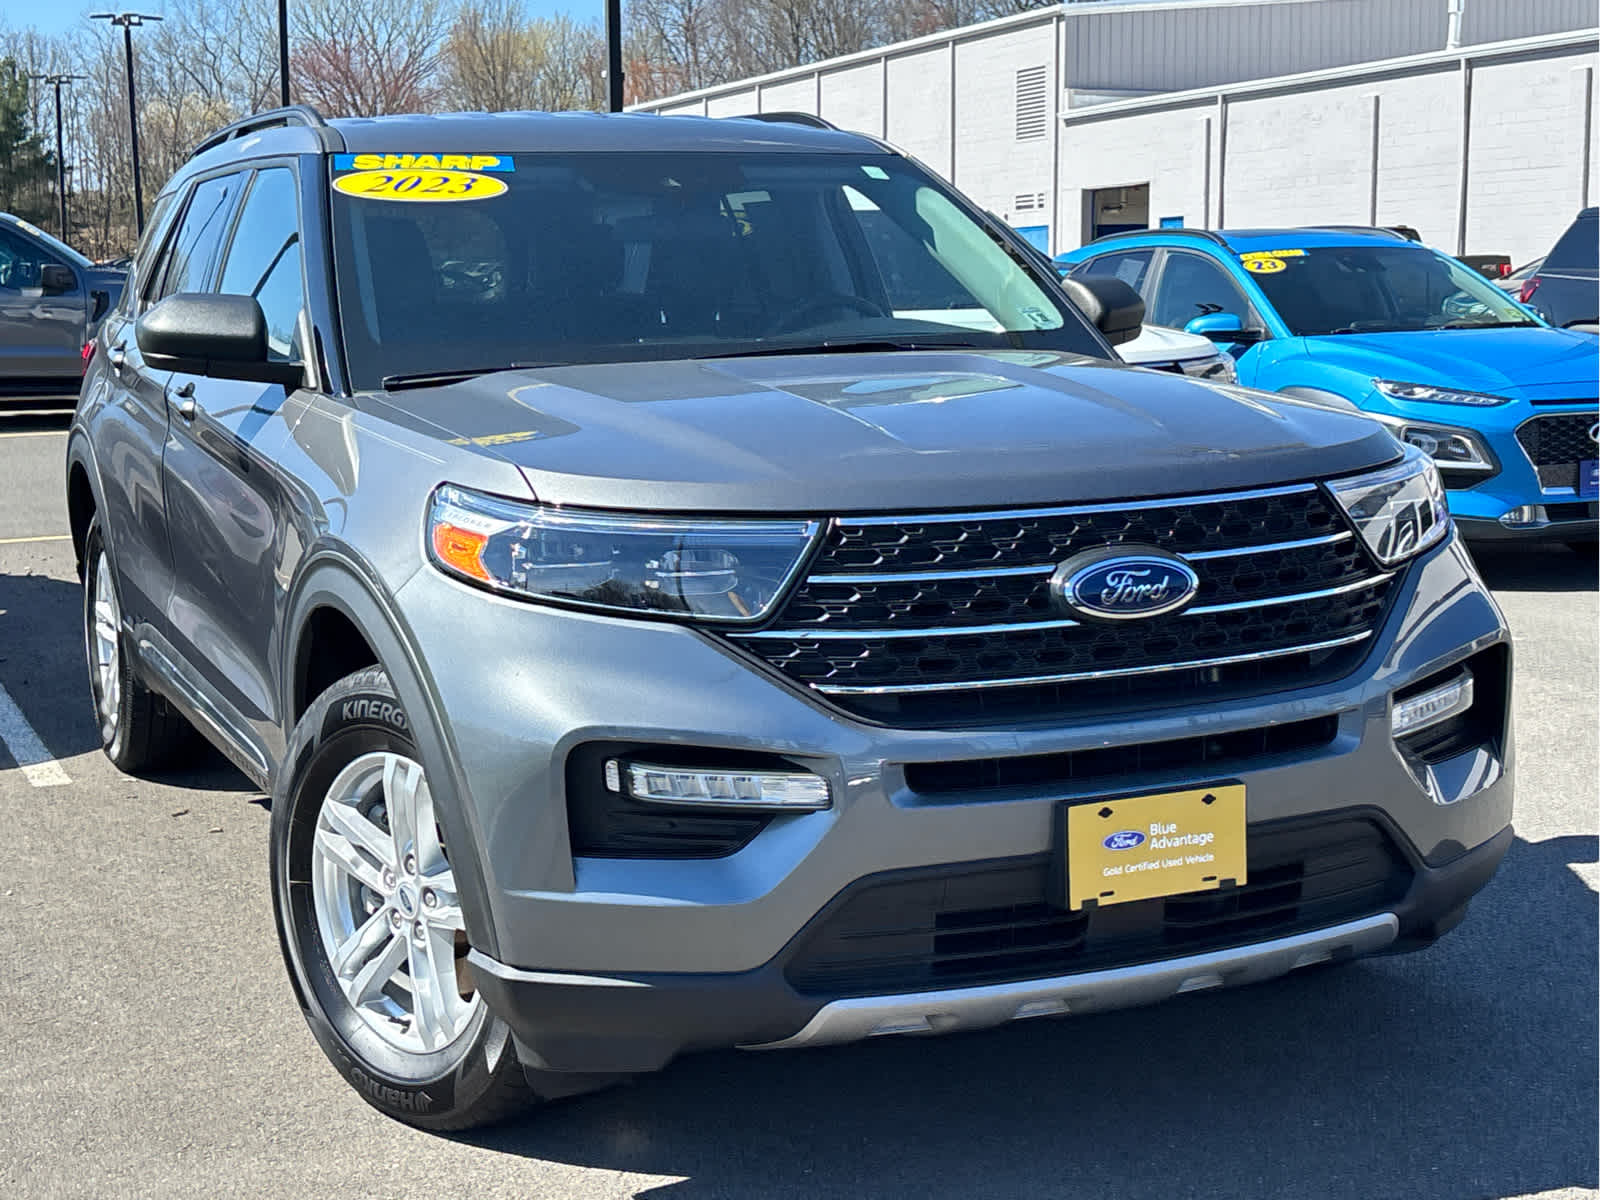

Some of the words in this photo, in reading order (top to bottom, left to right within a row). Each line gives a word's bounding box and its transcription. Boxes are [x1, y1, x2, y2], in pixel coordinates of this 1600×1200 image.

[353, 154, 500, 170] SHARP
[362, 175, 478, 194] 2023
[1251, 260, 1278, 270] 23
[1101, 569, 1169, 605] Ford
[342, 699, 409, 730] KINERG
[1150, 823, 1177, 836] Blue
[1110, 833, 1139, 848] Ford
[1150, 832, 1214, 849] Advantage
[1103, 867, 1123, 877] Gold
[1125, 860, 1160, 873] Certified
[1162, 857, 1183, 867] Used
[1186, 853, 1215, 864] Vehicle
